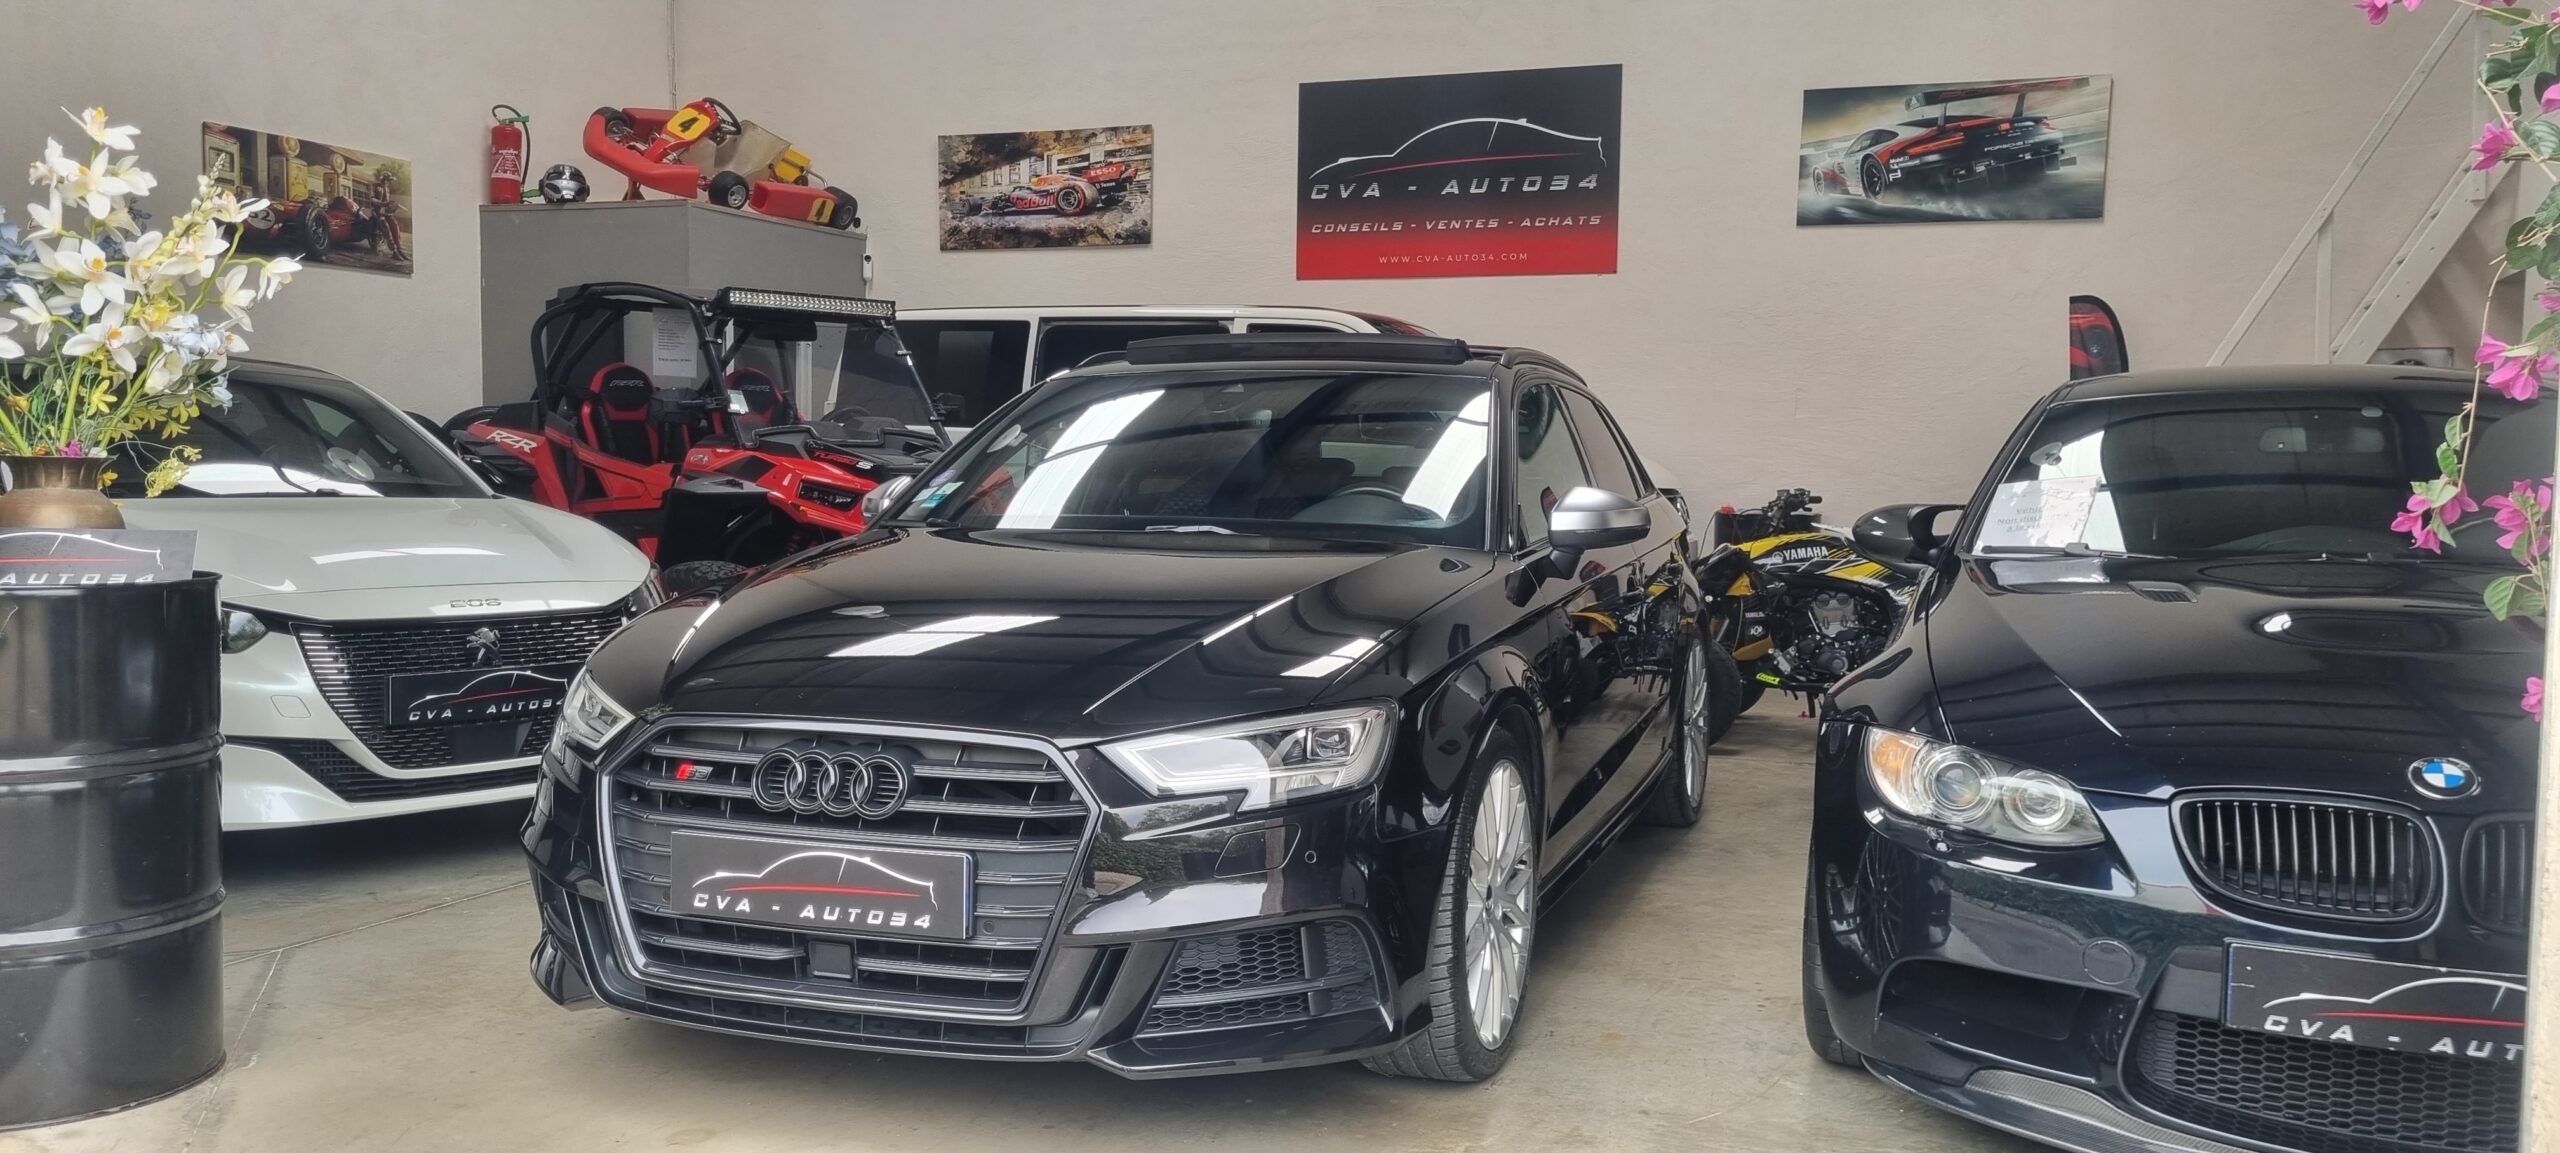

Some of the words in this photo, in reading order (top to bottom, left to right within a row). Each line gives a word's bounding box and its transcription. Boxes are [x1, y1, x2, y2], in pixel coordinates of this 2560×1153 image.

[677, 116, 700, 134] 4
[1310, 182, 1381, 200] CVA
[1440, 173, 1599, 195] AUTO34
[814, 199, 827, 221] 4
[1311, 221, 1404, 233] CONSEILS
[1424, 218, 1500, 230] VENTES
[1520, 215, 1602, 227] ACHATS
[1378, 252, 1529, 264] WWW.CVA-AUTO34.COM
[485, 429, 539, 453] RZR
[813, 450, 859, 466] TURBO
[1783, 545, 1830, 561] YAMAHA
[0, 572, 155, 585] AUTO34
[408, 708, 453, 721] CVA
[693, 893, 751, 912] CVA
[799, 903, 932, 929] AUTO34
[2263, 1014, 2355, 1042] CVA
